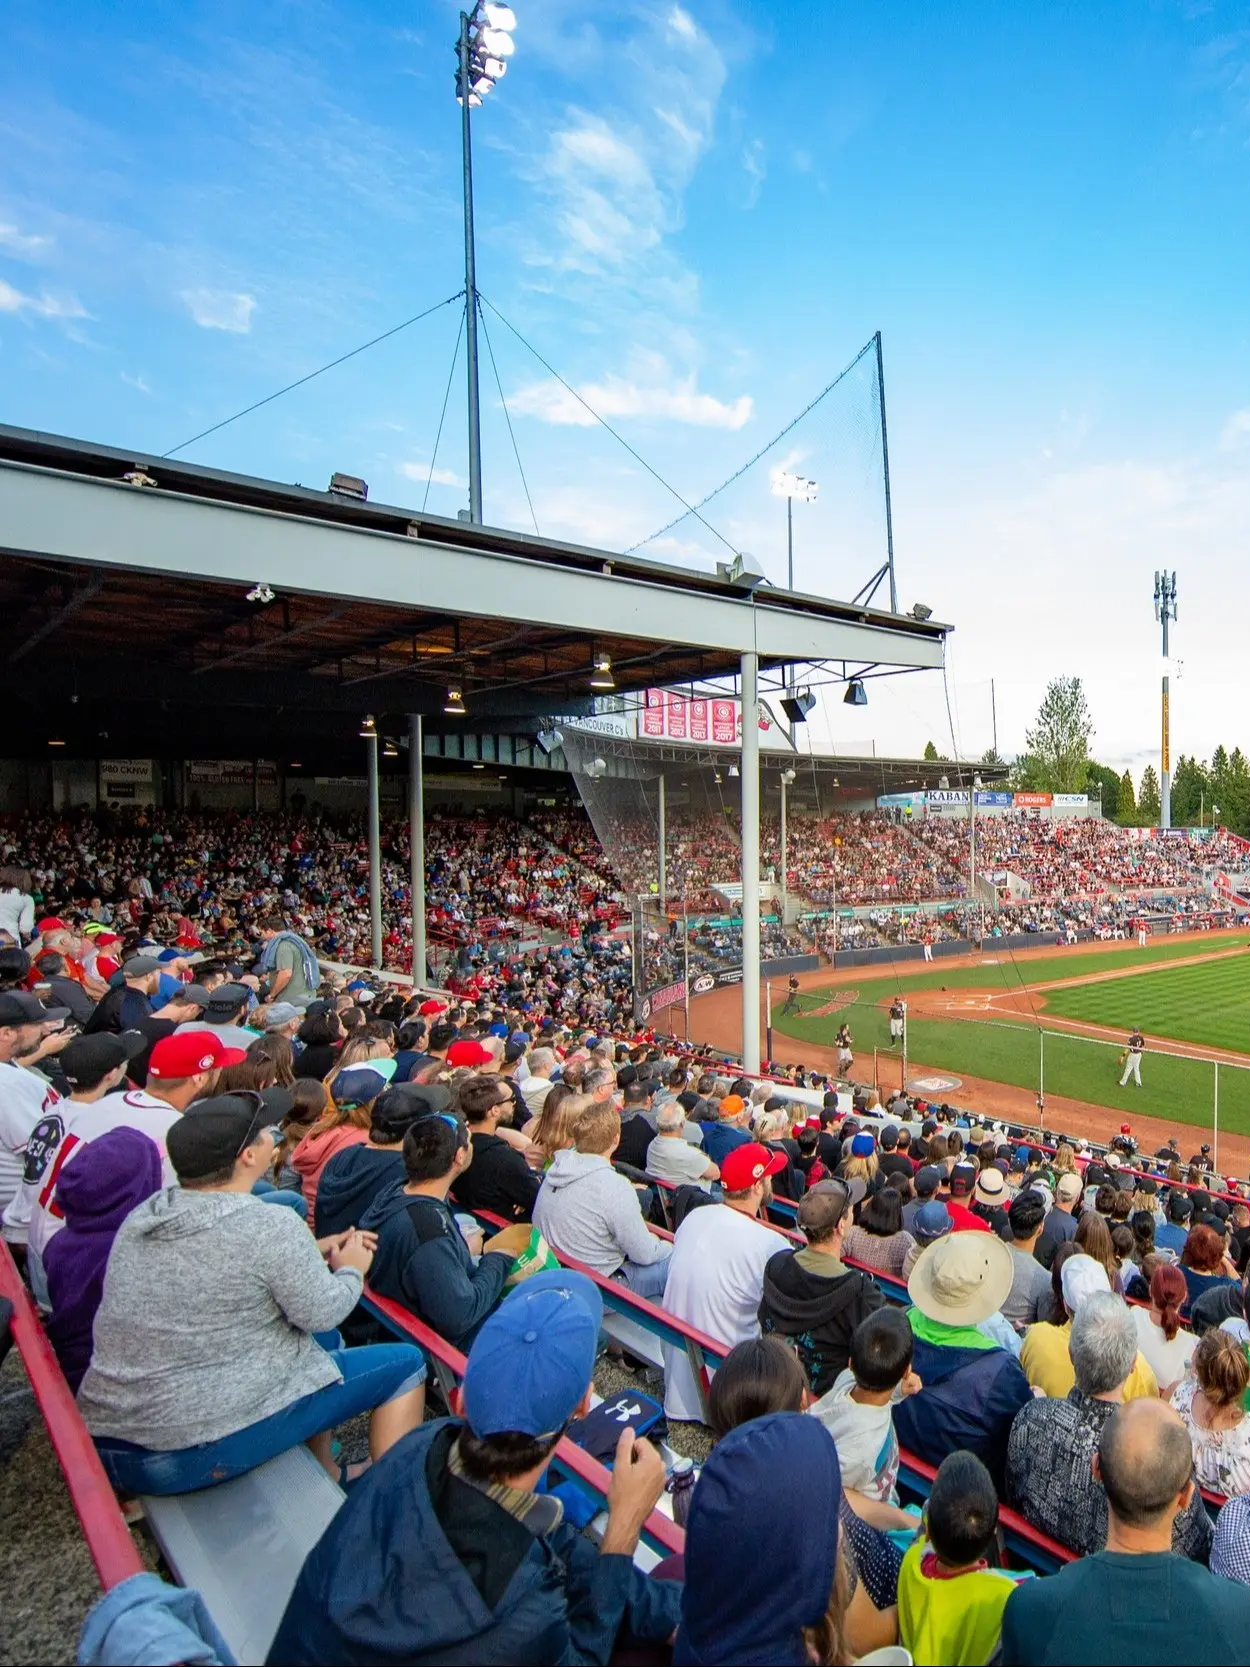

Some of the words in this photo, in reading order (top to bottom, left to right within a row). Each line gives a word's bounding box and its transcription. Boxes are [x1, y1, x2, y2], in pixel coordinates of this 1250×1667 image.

[715, 732, 733, 741] 2017
[928, 791, 968, 801] KABAN
[1025, 796, 1046, 804] ROGERS
